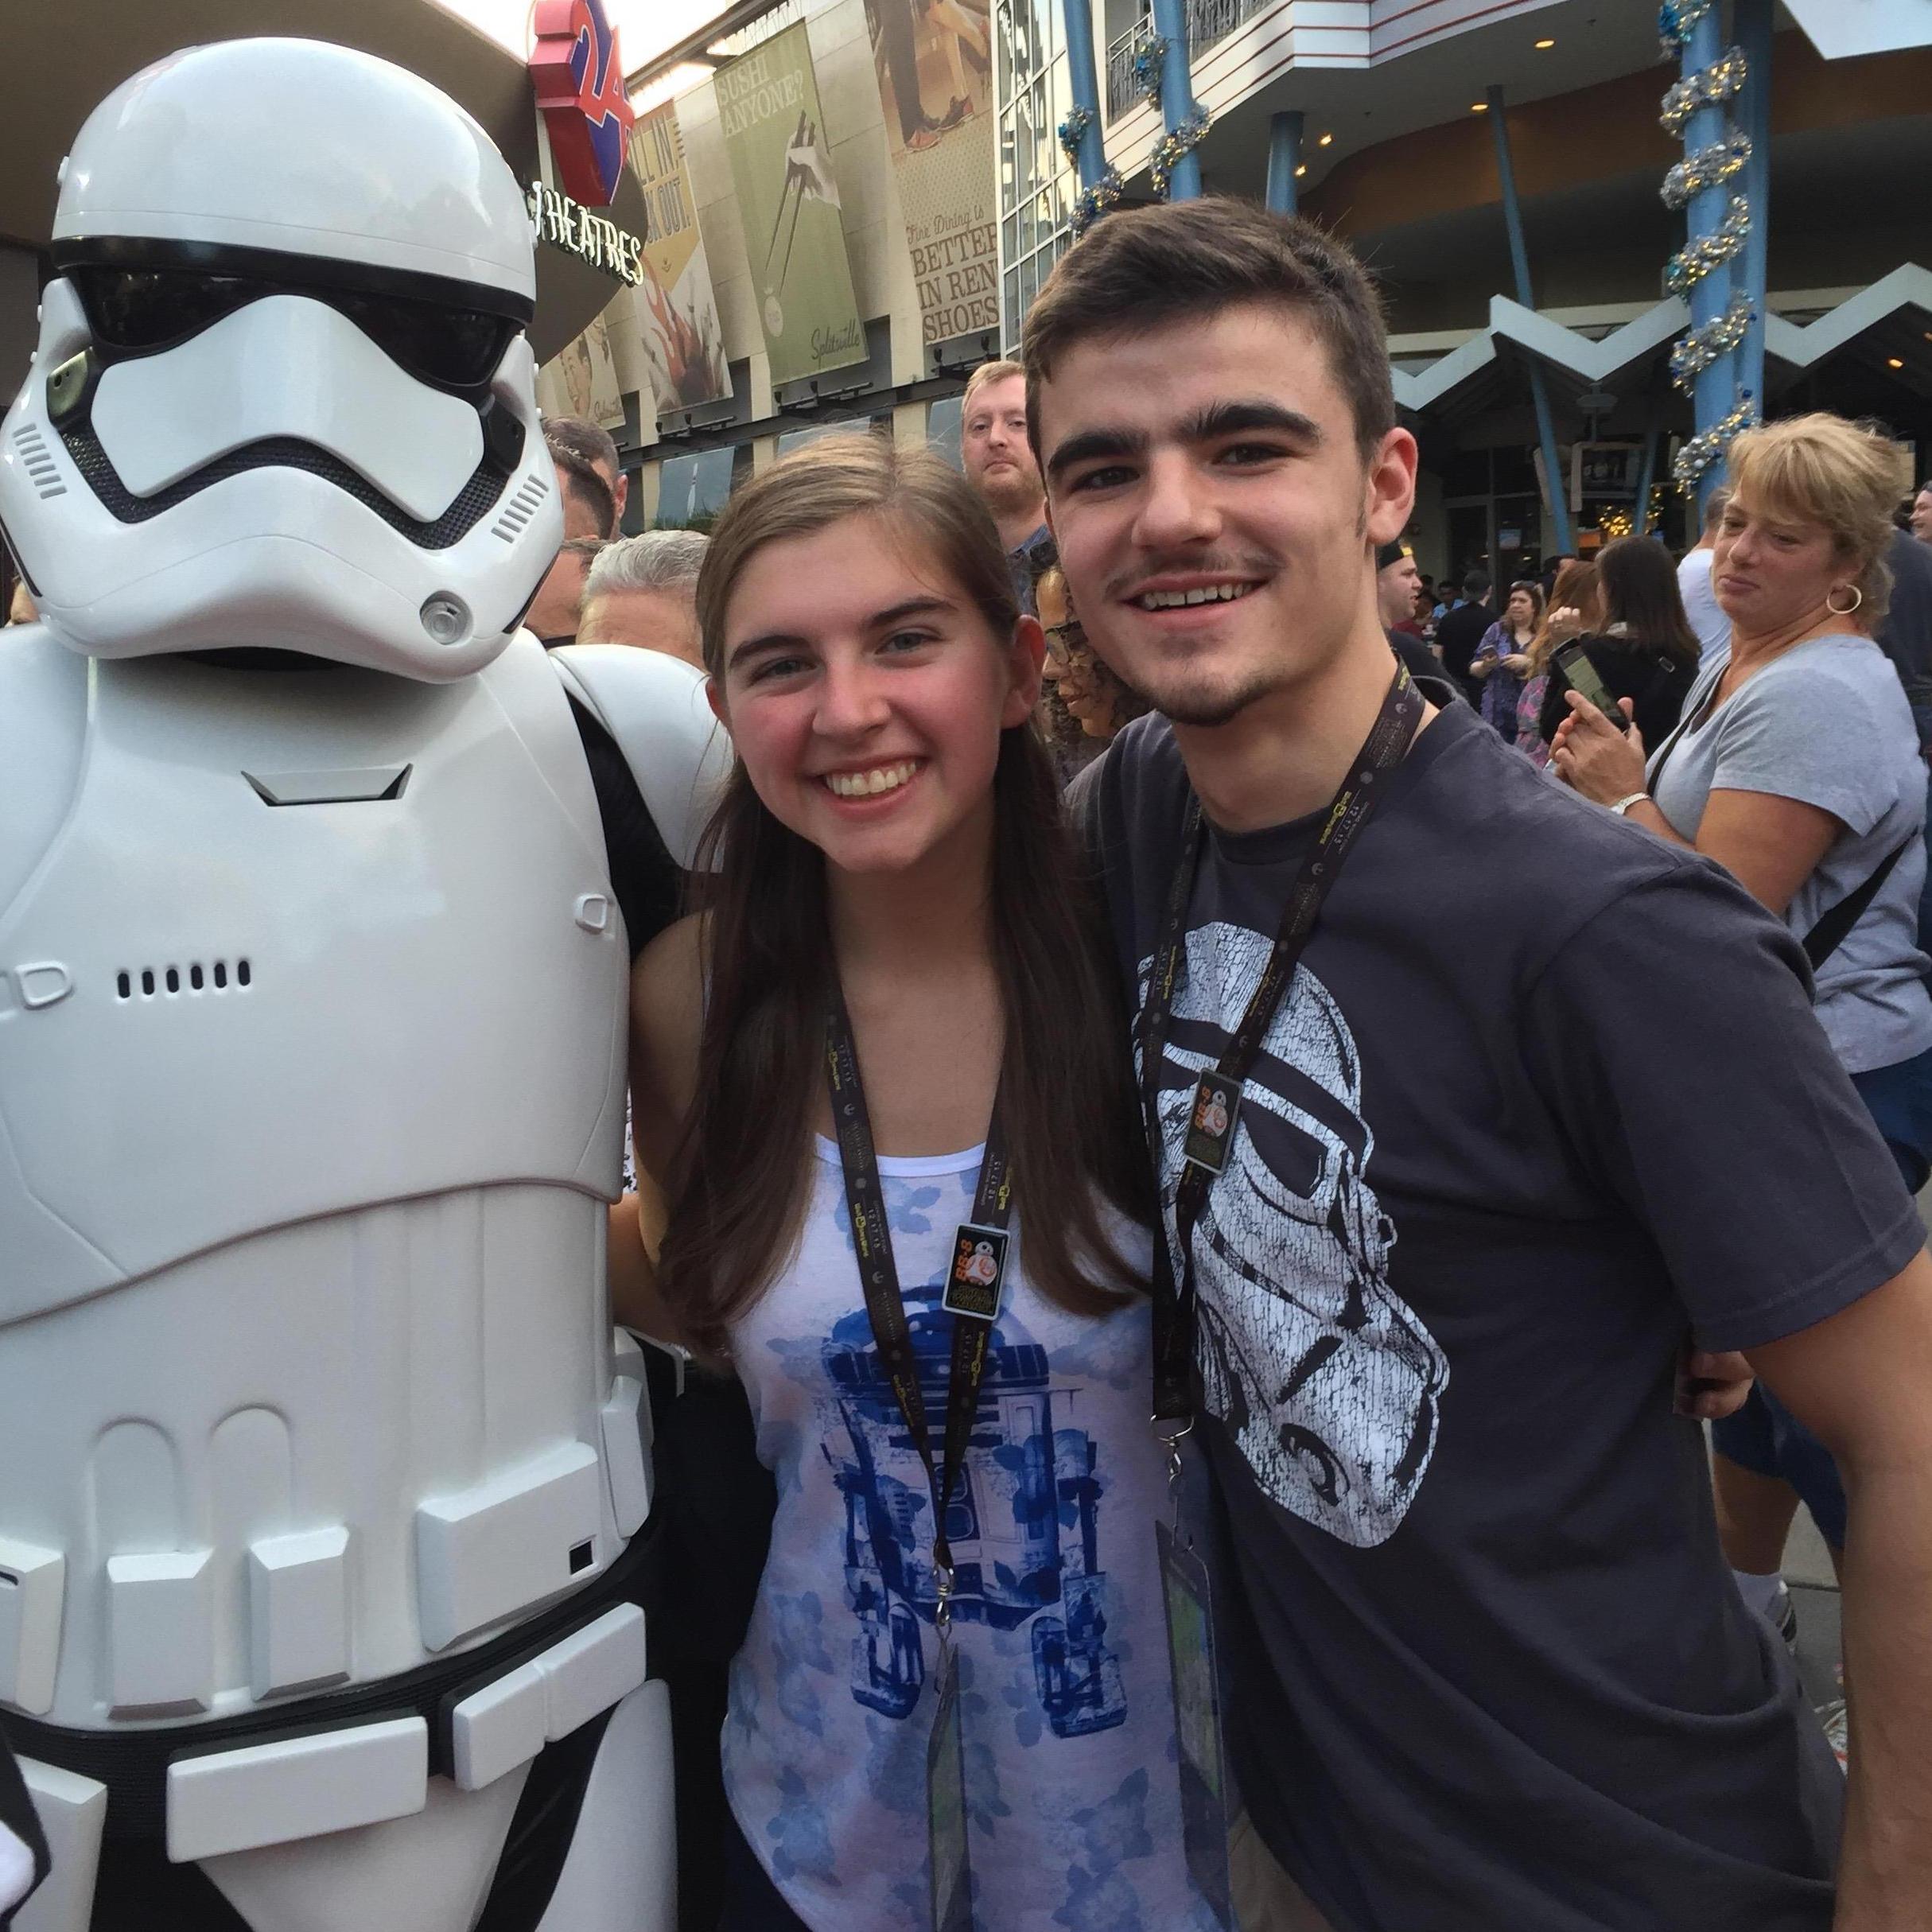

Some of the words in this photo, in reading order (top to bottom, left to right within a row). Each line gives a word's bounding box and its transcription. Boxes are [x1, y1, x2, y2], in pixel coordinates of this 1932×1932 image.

[716, 52, 769, 105] SUSHI
[725, 69, 804, 138] ANYONE?
[531, 181, 644, 286] THEATRES
[906, 224, 931, 245] Fine
[933, 213, 972, 235] Dining
[915, 277, 943, 311] IN
[946, 258, 999, 301] REN
[922, 295, 1000, 342] SHOES
